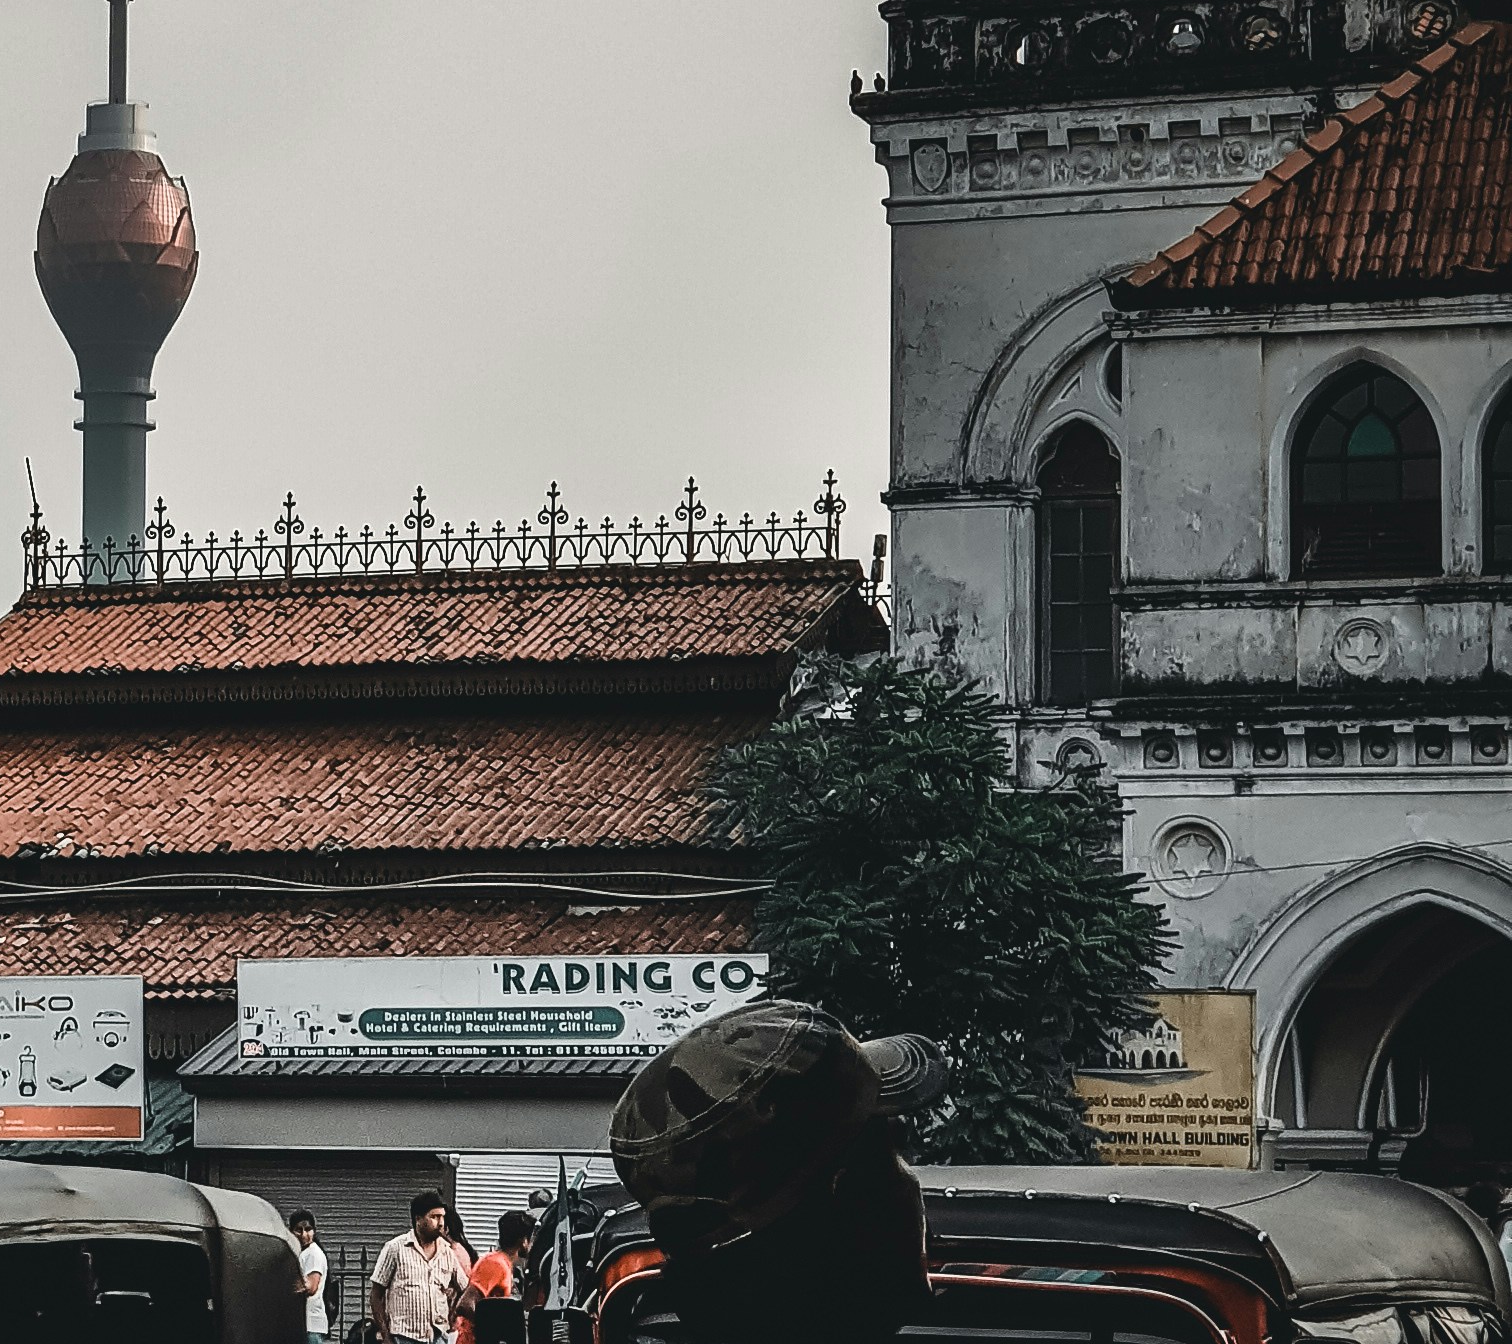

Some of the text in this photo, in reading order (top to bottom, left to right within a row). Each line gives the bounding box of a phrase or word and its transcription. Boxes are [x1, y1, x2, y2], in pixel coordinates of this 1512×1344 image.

[493, 962, 673, 994] RADING
[384, 1012, 427, 1022] Dealers
[445, 1011, 493, 1022] Stainless
[497, 1011, 526, 1021] Steel
[530, 1010, 593, 1021] Household
[366, 1023, 397, 1033] Hotel
[413, 1022, 462, 1034] Catering
[466, 1022, 546, 1034] Requirements
[293, 1047, 324, 1056] Town
[1142, 1131, 1181, 1145] HALL
[1184, 1132, 1250, 1146] BUILDING
